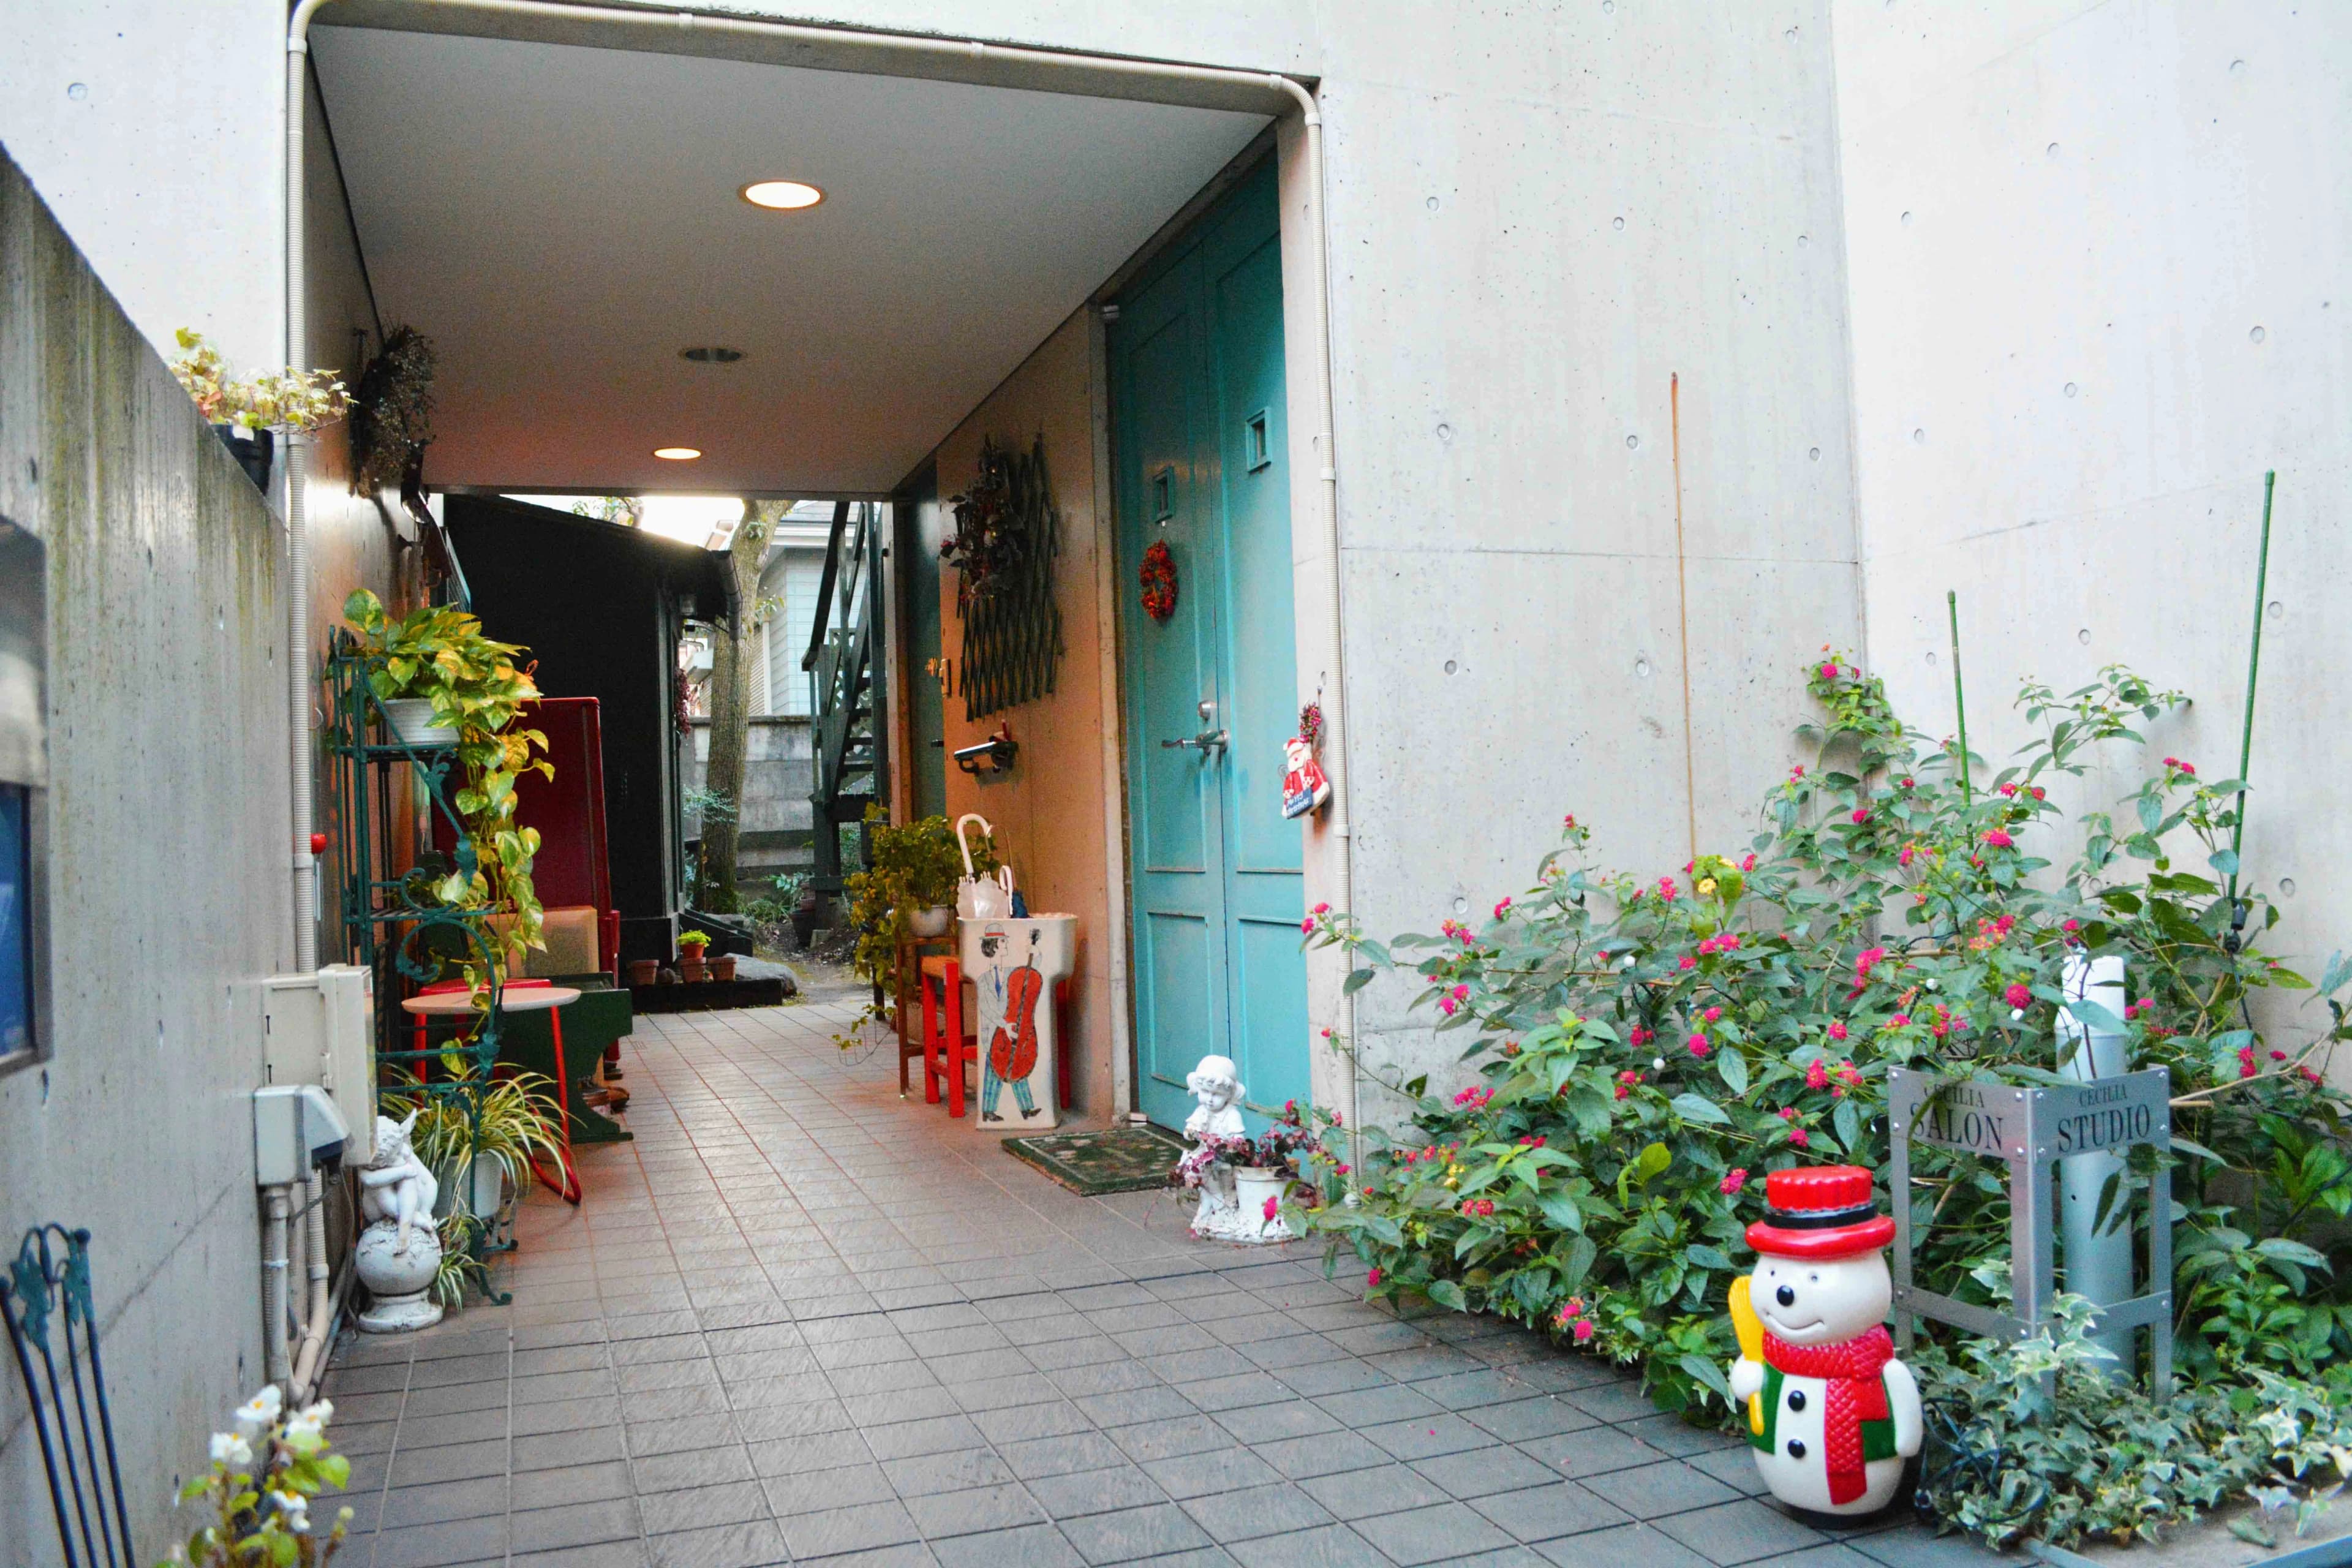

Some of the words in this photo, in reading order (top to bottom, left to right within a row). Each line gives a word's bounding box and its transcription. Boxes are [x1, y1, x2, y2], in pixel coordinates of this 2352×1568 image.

[2079, 1083, 2128, 1107] CECILIA
[1910, 1102, 2003, 1151] SALON
[2058, 1104, 2150, 1153] STUDIO
